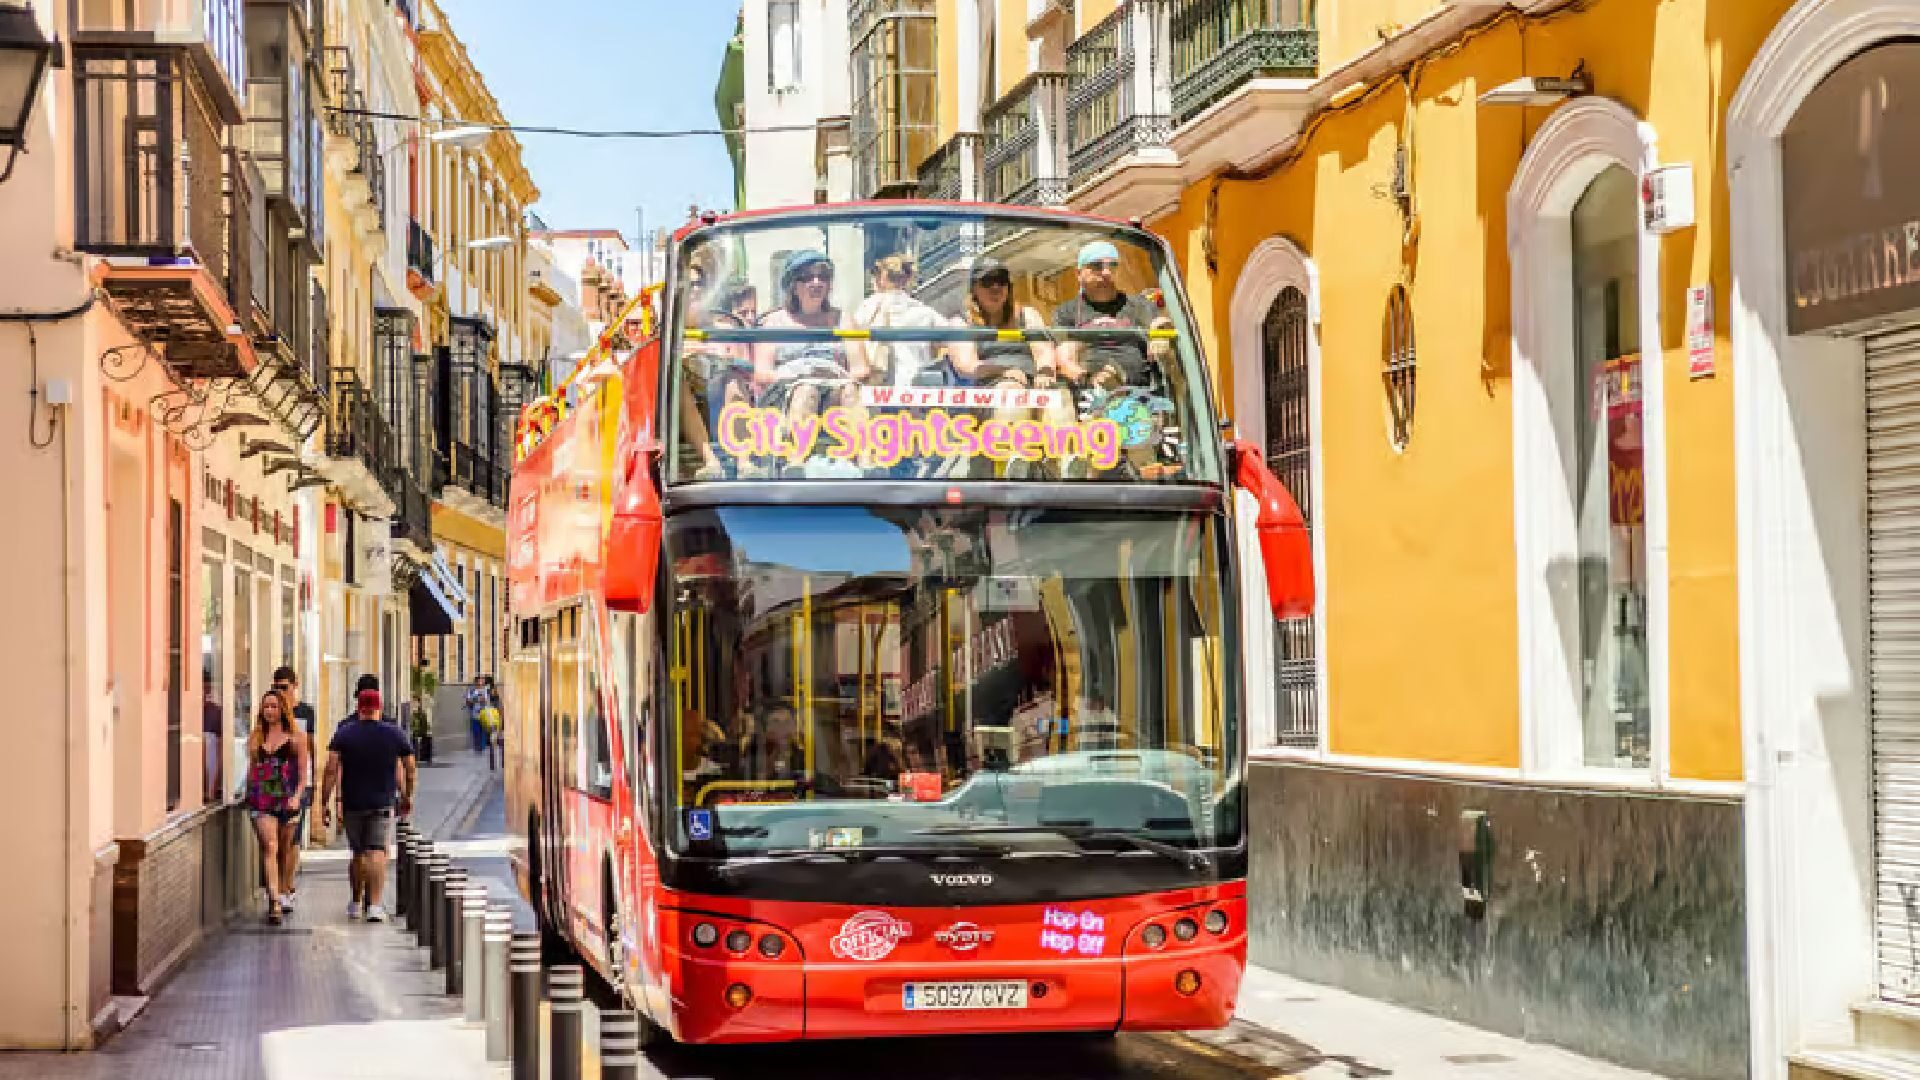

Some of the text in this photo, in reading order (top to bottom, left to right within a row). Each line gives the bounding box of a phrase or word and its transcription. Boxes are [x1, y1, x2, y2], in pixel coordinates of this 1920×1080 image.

[872, 388, 1051, 406] Worldwide
[718, 402, 1120, 471] City Sightseeing
[930, 873, 993, 887] VOLVO
[1043, 906, 1105, 931] Hop On
[1040, 929, 1076, 953] Hop
[923, 983, 1020, 1008] 5097 CVZ
